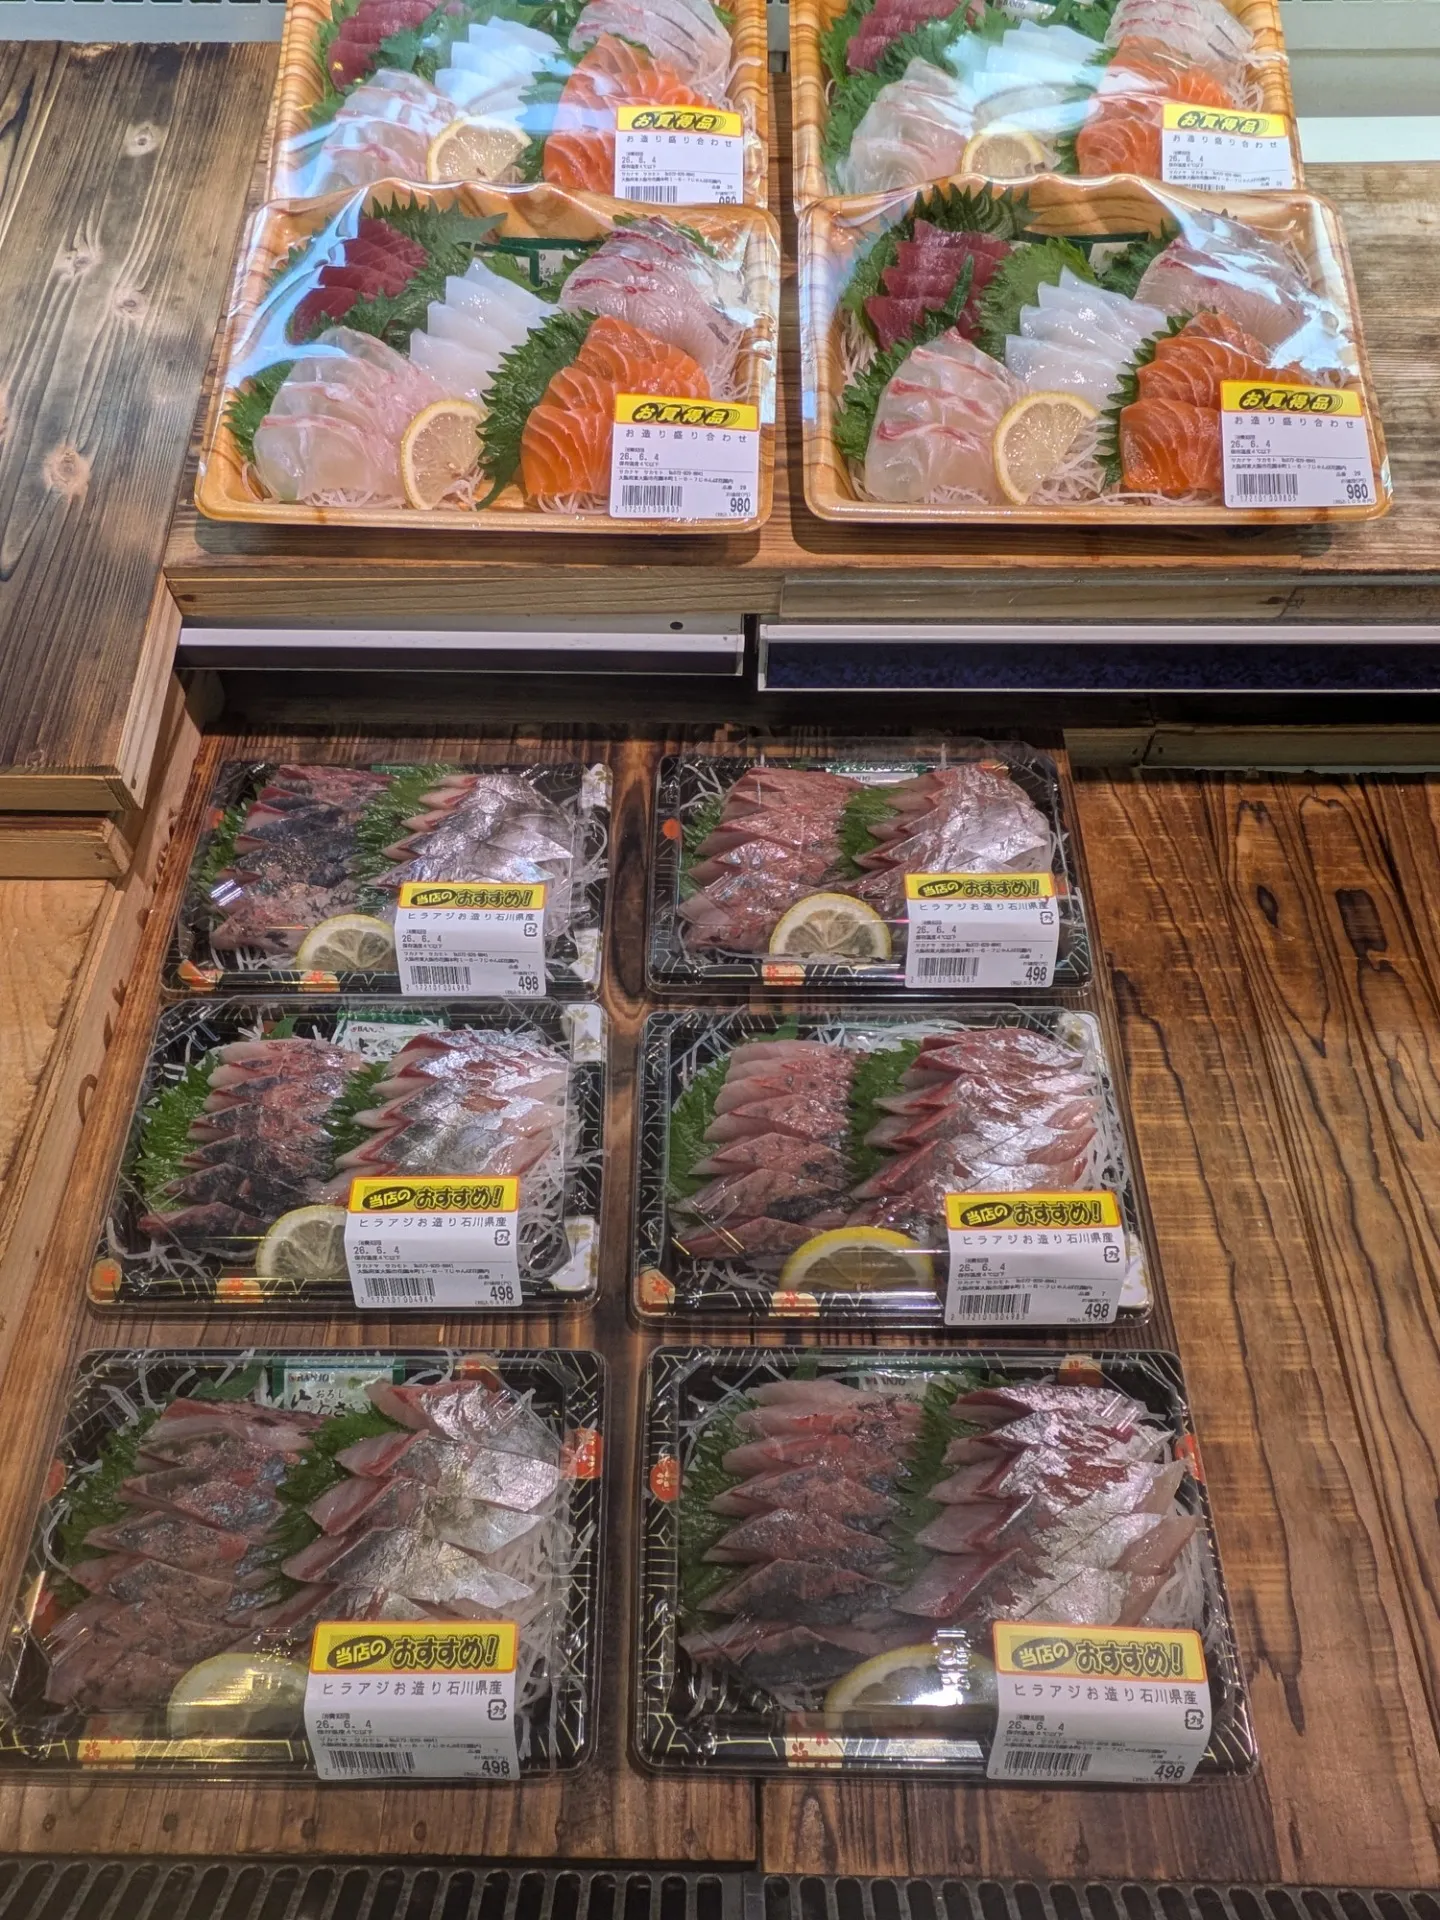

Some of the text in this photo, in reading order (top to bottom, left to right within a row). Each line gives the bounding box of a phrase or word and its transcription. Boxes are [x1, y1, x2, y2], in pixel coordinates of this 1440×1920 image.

[633, 113, 717, 130] お買得品
[1180, 112, 1259, 133] お買得品
[627, 135, 732, 147] お造り盛り合わせ
[1173, 135, 1276, 148] お造り盛り合わせ
[1241, 392, 1331, 412] お買得品
[634, 405, 727, 424] お買得品
[1235, 416, 1354, 428] お造り盛り合わせ
[626, 429, 746, 442] お造り盛り合わせ
[1347, 484, 1368, 499] 980
[731, 498, 750, 512] 980
[918, 880, 1039, 897] 当店のおすすめ!
[411, 889, 532, 906] 当店のおすすめ!
[920, 902, 1048, 910] ヒラアジお造り石川県産
[409, 913, 535, 921] ヒラアジお造り石川県産
[1026, 967, 1047, 981] 498
[519, 977, 539, 990] 498
[362, 1186, 504, 1210] 当店のおすすめ!
[960, 1201, 1102, 1227] 当店のおすすめ!
[360, 1217, 507, 1227] ヒラアジお造り石川県産
[964, 1233, 1114, 1244] ヒラアジお造り石川県産
[1000, 1263, 1005, 1271] 4
[490, 1287, 513, 1300] 498
[1085, 1304, 1109, 1318] 498
[327, 1635, 499, 1669] 当店のおすすめ!
[1012, 1637, 1184, 1676] 当店のおすすめ!
[324, 1681, 502, 1695] ヒラアジお造り石川県産
[1015, 1684, 1198, 1705] ヒラアジお造り石川県産
[366, 1720, 372, 1728] 4
[1058, 1723, 1065, 1731] 4
[481, 1761, 510, 1774] 498
[1155, 1765, 1185, 1779] 498
